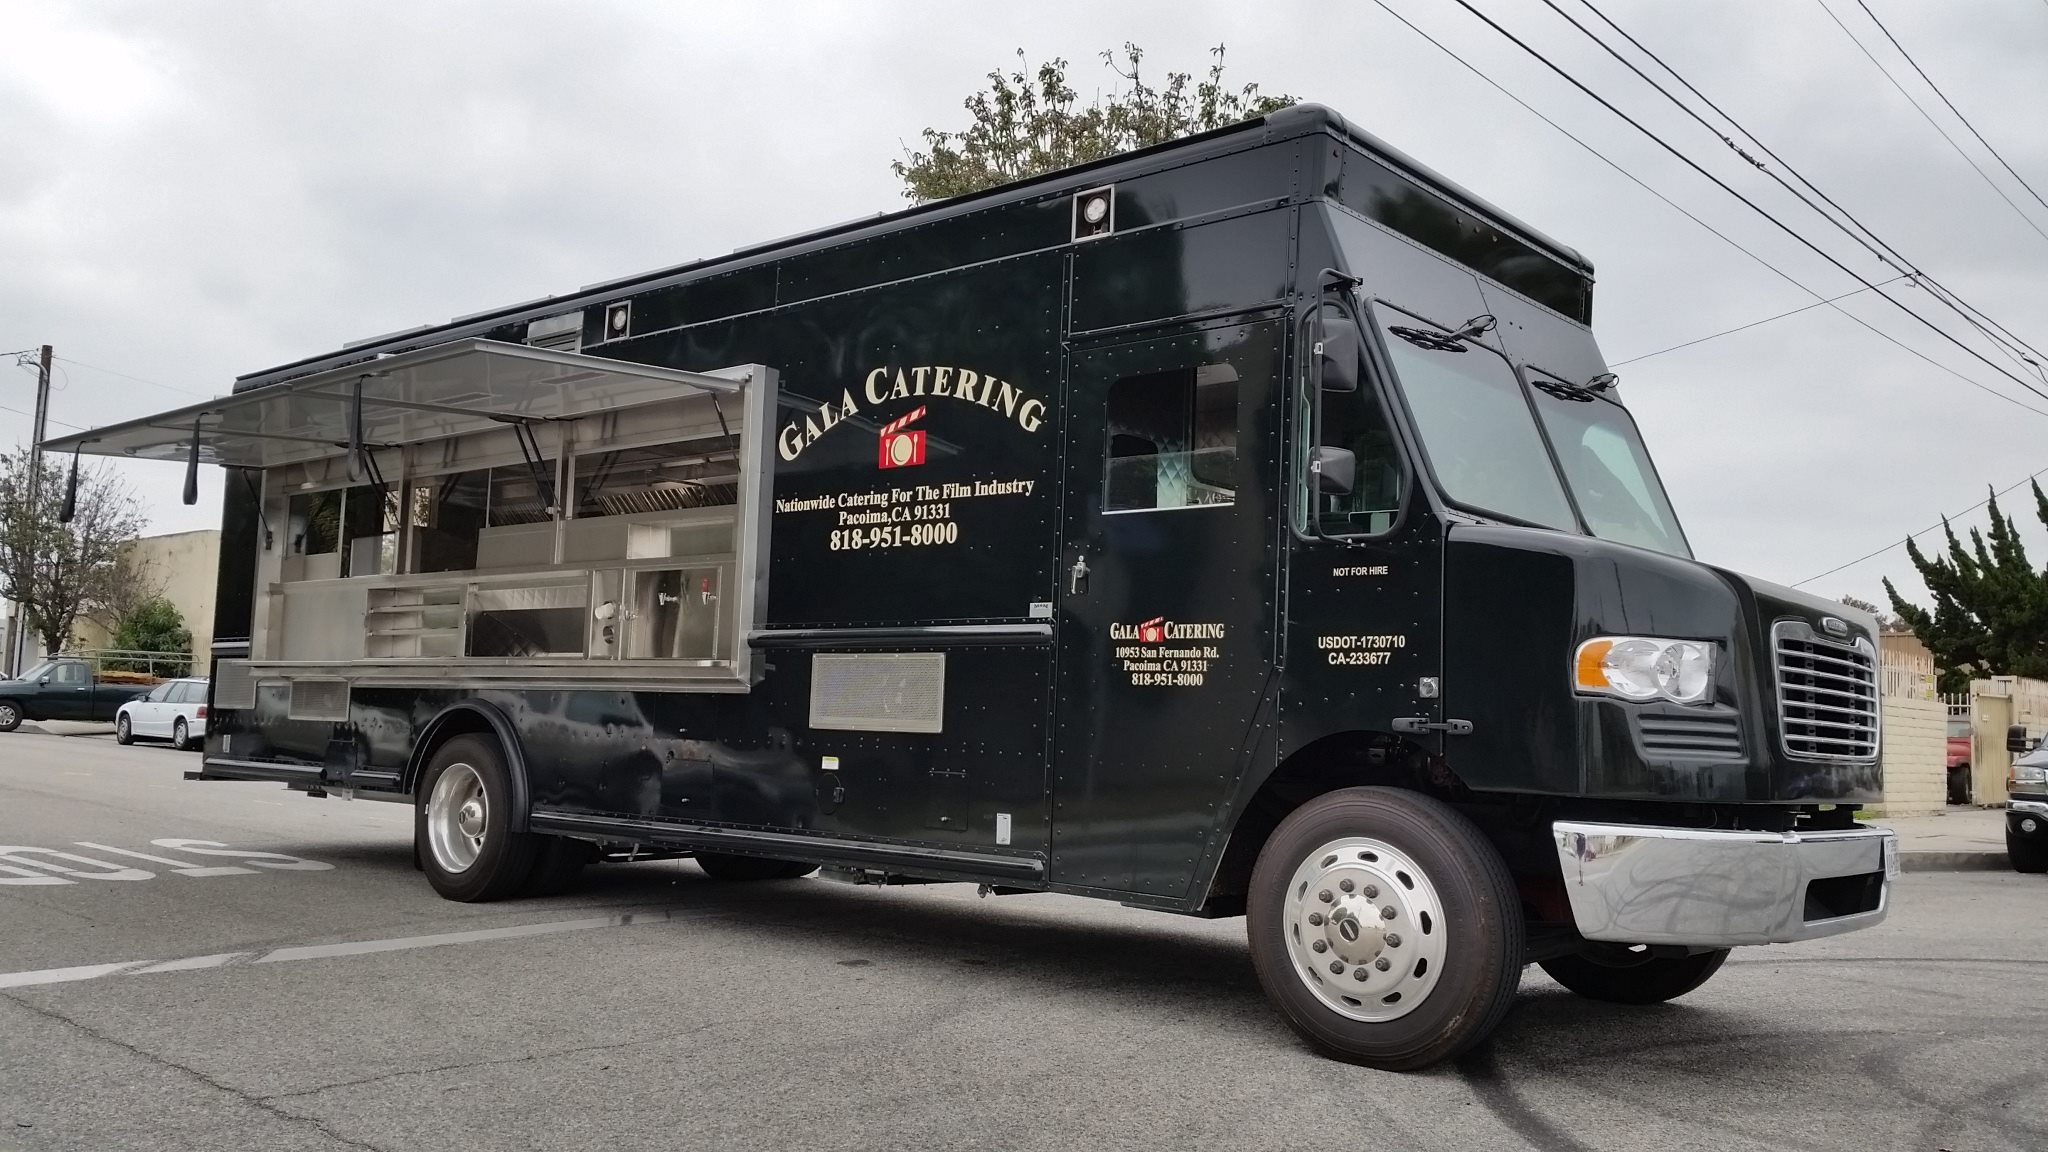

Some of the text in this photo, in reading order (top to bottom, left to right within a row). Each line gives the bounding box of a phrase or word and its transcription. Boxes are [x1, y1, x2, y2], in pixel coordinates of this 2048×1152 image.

[777, 365, 1047, 462] GALA CATERING
[775, 478, 1035, 514] Nationwide Catering For The Film Industry
[914, 502, 951, 520] 91331
[829, 521, 958, 551] 818-951-8000
[1332, 565, 1389, 577] NOT FOR HIRE
[1109, 620, 1225, 640] GALA CATERING
[1317, 635, 1406, 649] USDOT-1730710
[1115, 646, 1220, 658] 10953 San Fernando Rd.
[1328, 652, 1392, 665] CA-233677
[1123, 660, 1208, 672] Pacoima CA 91331
[1131, 673, 1204, 686] 818-951-8000
